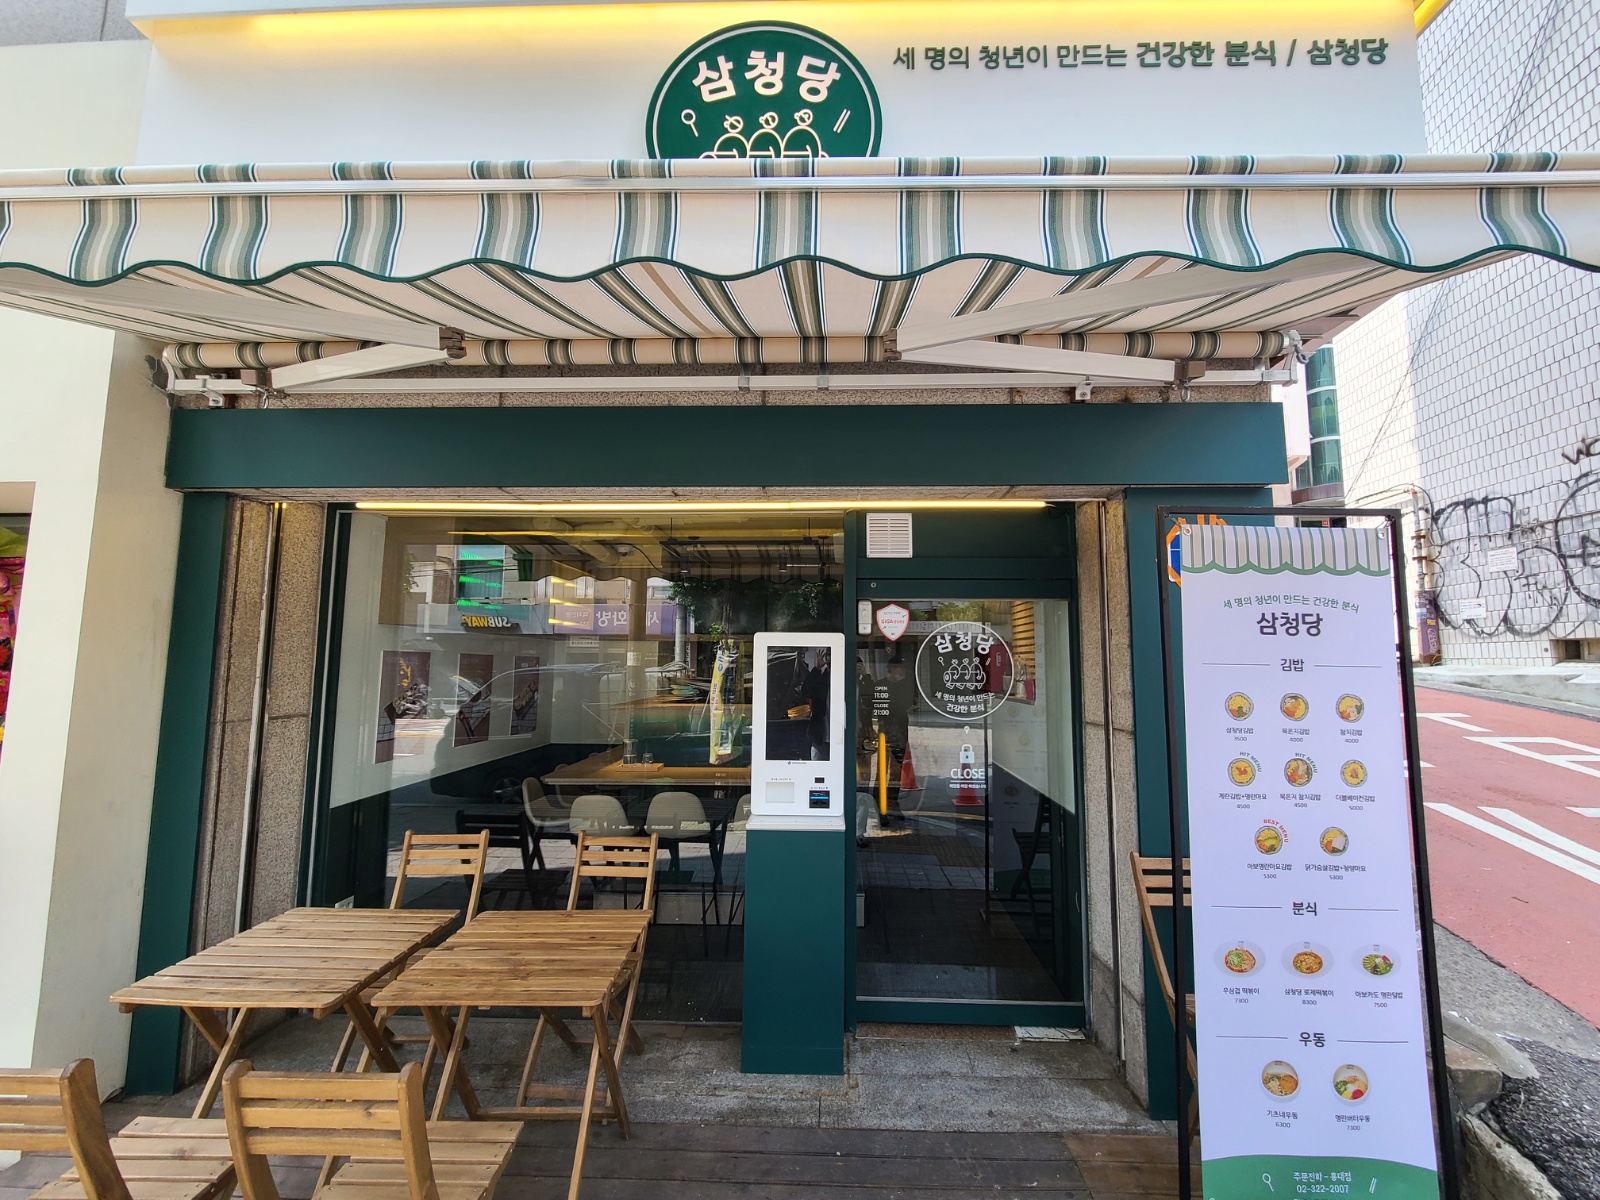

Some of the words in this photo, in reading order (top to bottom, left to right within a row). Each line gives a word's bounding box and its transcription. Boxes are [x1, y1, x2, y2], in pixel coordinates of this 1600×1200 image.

[893, 47, 915, 69] 세
[924, 46, 970, 70] 명의
[979, 45, 1048, 69] 청년이
[1057, 44, 1128, 68] 만드는
[1136, 41, 1215, 67] 건강한
[1224, 39, 1276, 66] 분식
[1307, 38, 1389, 66] 삼청당
[692, 50, 841, 103] 삼청당
[1224, 599, 1233, 609] 세
[1234, 596, 1253, 607] 명의
[1255, 594, 1281, 606] 청년이
[1283, 594, 1310, 606] 만드는
[1313, 596, 1339, 608] 건강한
[1341, 600, 1360, 613] 분식
[1257, 612, 1323, 637] 삼청당
[934, 631, 995, 655] 삼청당
[1280, 658, 1304, 672] 김밥
[934, 691, 942, 699] 세
[943, 693, 955, 702] 명의
[957, 694, 975, 703] 청년이
[976, 691, 996, 701] 만드는
[946, 703, 968, 713] 건강한
[969, 703, 985, 713] 분식
[1226, 727, 1254, 735] 삼청당김밥
[1340, 729, 1363, 737] 참치김밥
[1250, 755, 1262, 773] MENU
[1306, 756, 1318, 774] MENU
[950, 768, 986, 779] CLOSE
[1278, 824, 1289, 843] MENU
[1292, 901, 1318, 916] 분식
[1242, 987, 1260, 995] 떡볶이
[1284, 988, 1302, 996] 삼청당
[1304, 988, 1334, 997] 로제떡볶이
[1299, 1032, 1326, 1048] 우동
[1293, 1172, 1322, 1182] 주문전화
[1330, 1172, 1352, 1182] 홍대점
[1296, 1184, 1349, 1194] 02-322-2007
